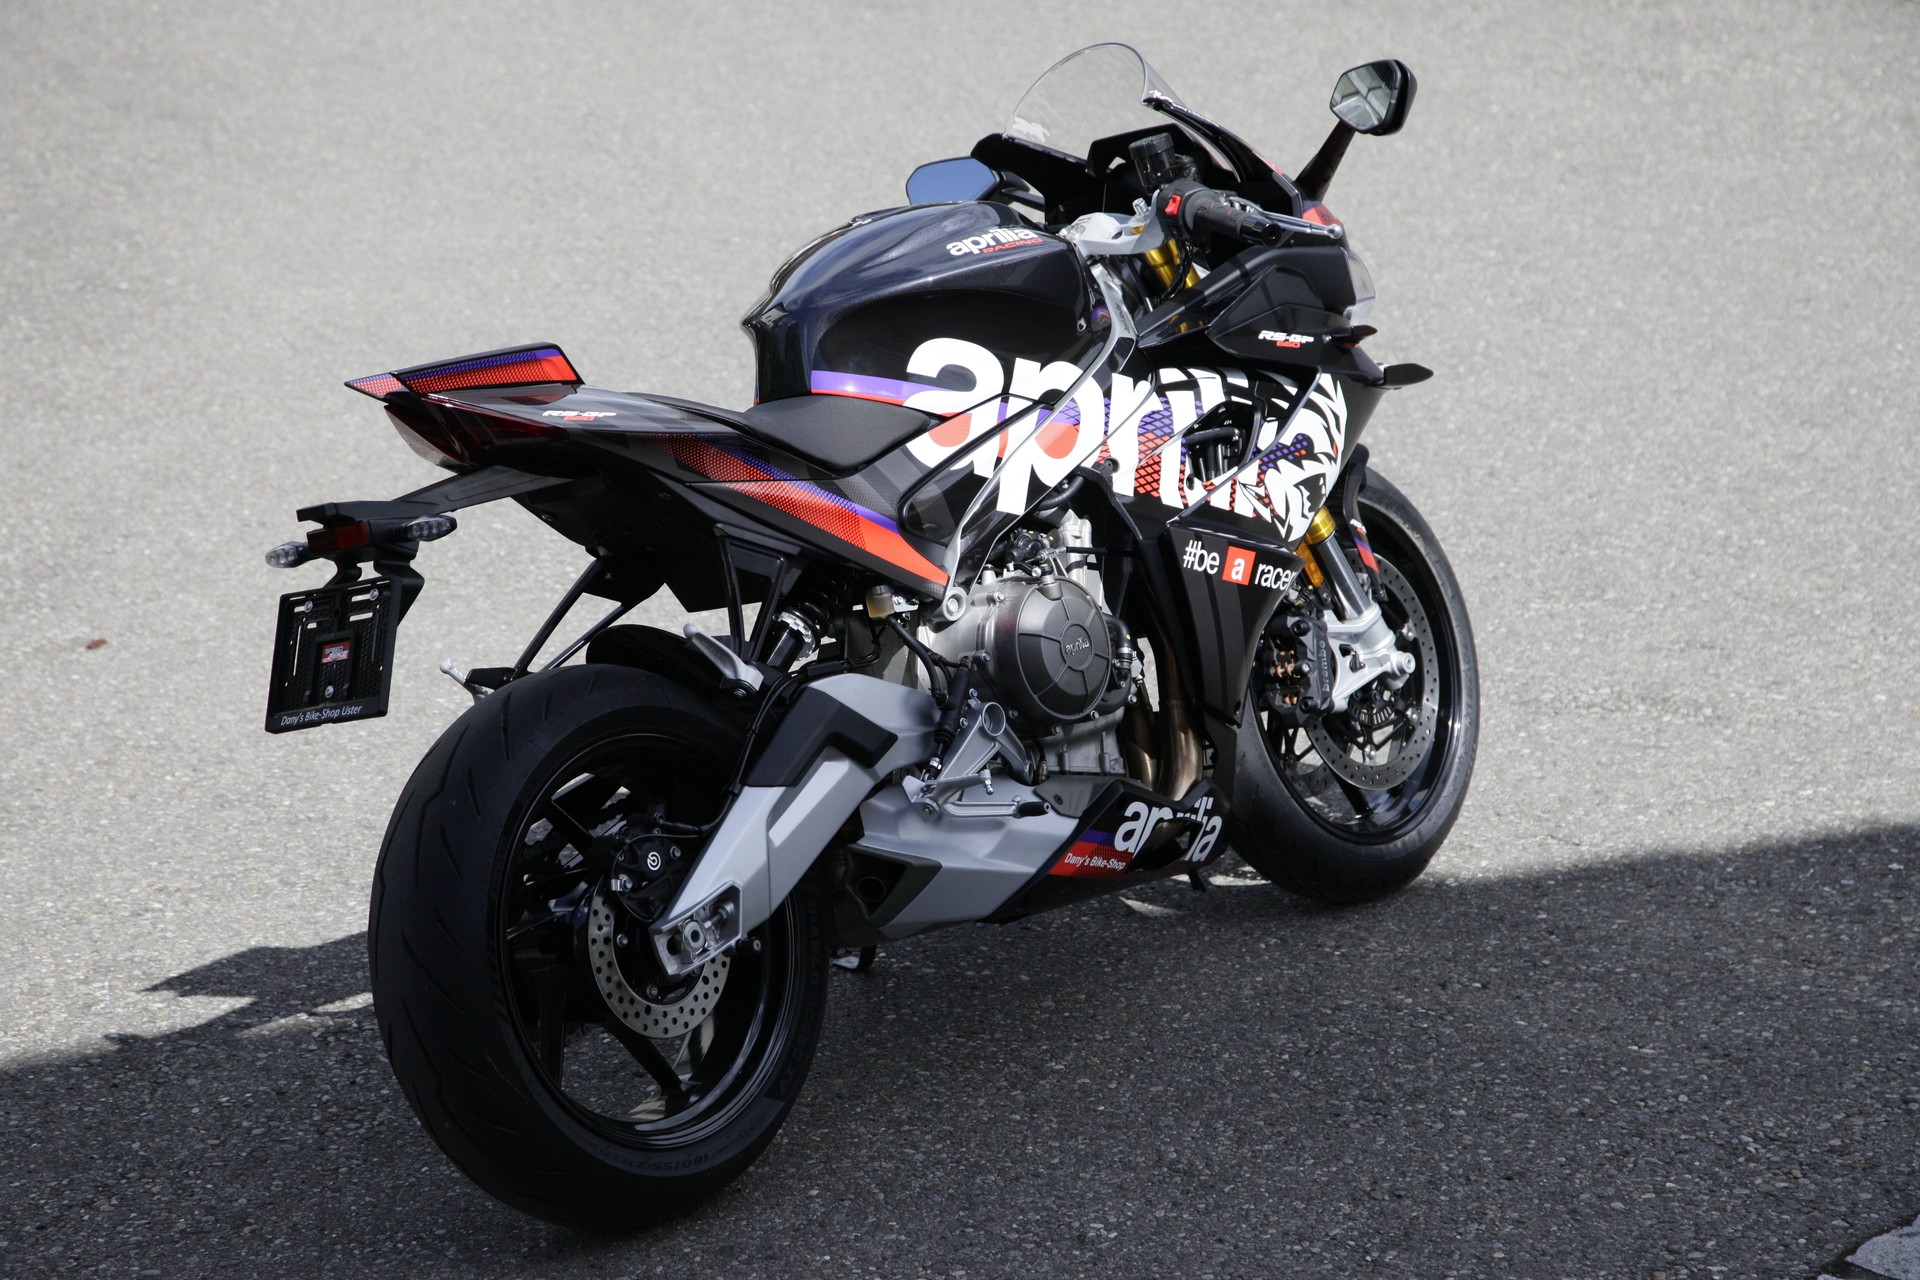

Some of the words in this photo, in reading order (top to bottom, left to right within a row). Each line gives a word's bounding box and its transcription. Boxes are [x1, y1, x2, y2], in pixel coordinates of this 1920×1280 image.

[946, 228, 1039, 256] aprilia
[982, 238, 1044, 254] RACING
[1258, 330, 1315, 343] RS-GP
[1182, 539, 1220, 575] #be
[1230, 557, 1246, 581] a
[1318, 640, 1331, 693] brembo
[280, 713, 304, 726] Dany's
[304, 708, 340, 722] Bike-Shop
[341, 705, 363, 716] Uster
[1114, 796, 1222, 862] apia
[1064, 853, 1090, 868] Dany's
[1089, 856, 1126, 871] Bike-Shop
